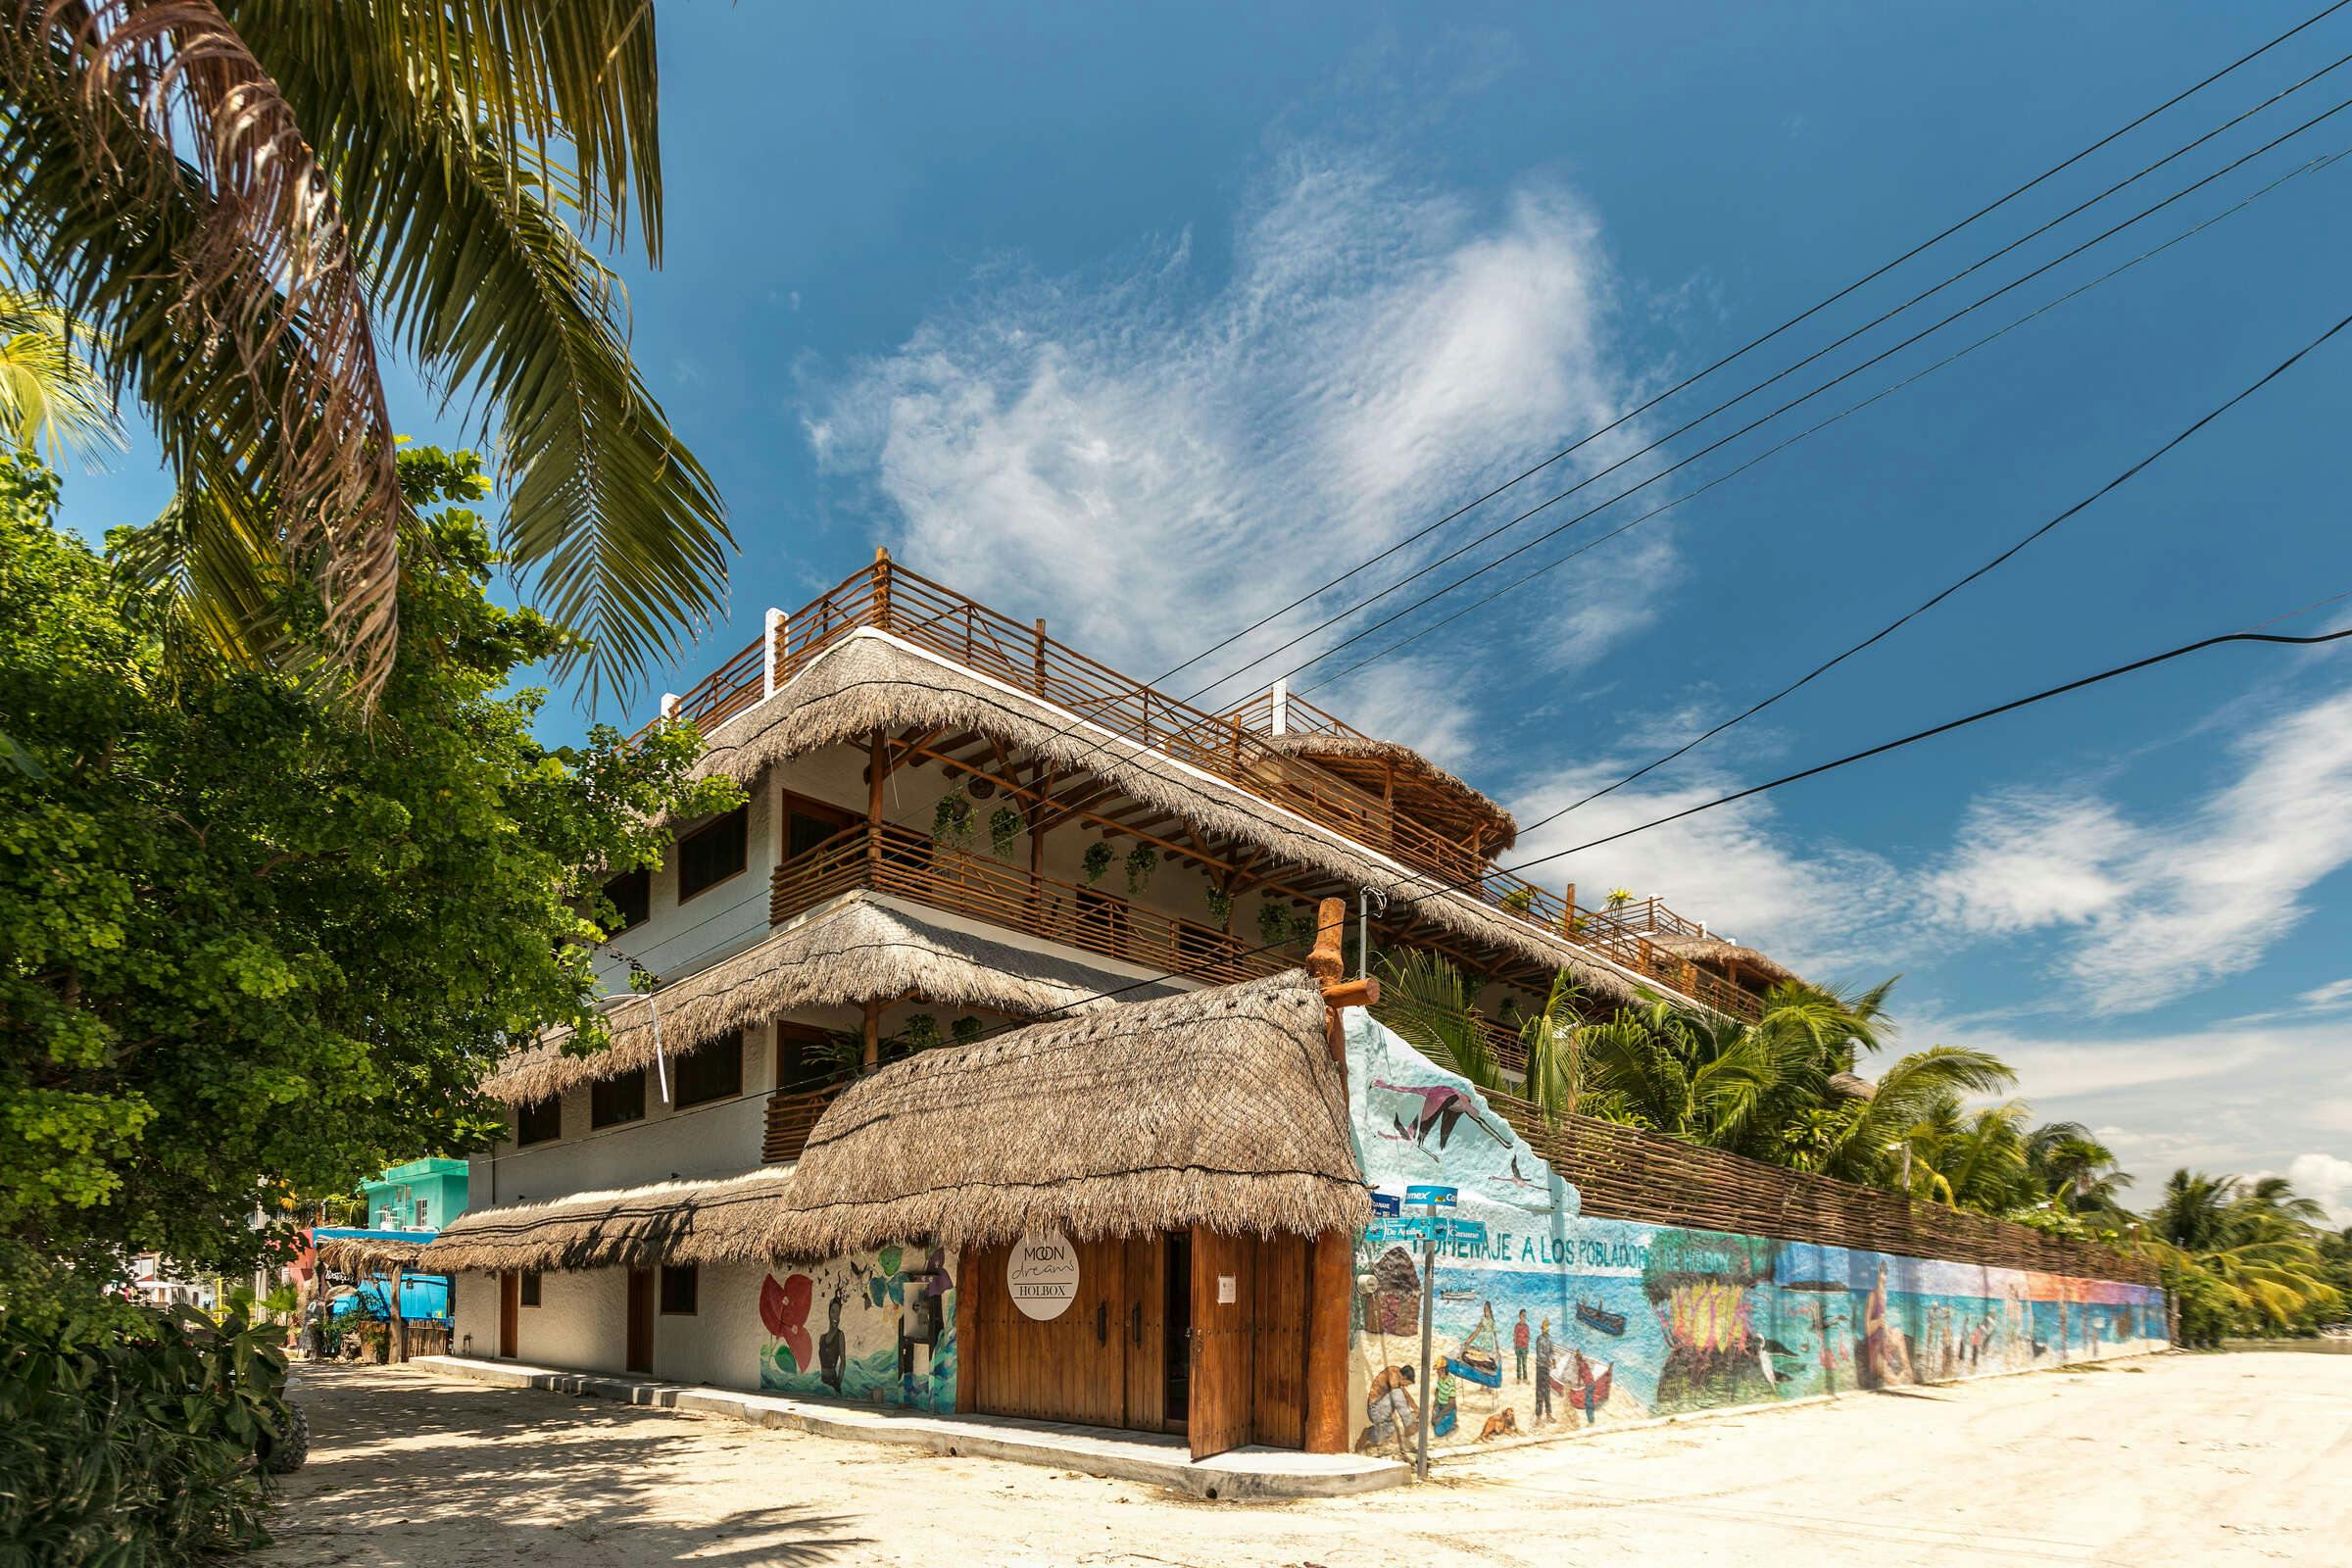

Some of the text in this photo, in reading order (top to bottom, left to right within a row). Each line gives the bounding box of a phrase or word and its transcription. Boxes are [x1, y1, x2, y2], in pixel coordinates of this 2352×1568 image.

[1024, 1246, 1064, 1261] MOON
[1521, 1236, 1536, 1263] A
[1541, 1236, 1575, 1265] LOS
[1019, 1285, 1066, 1297] HOLBOX
